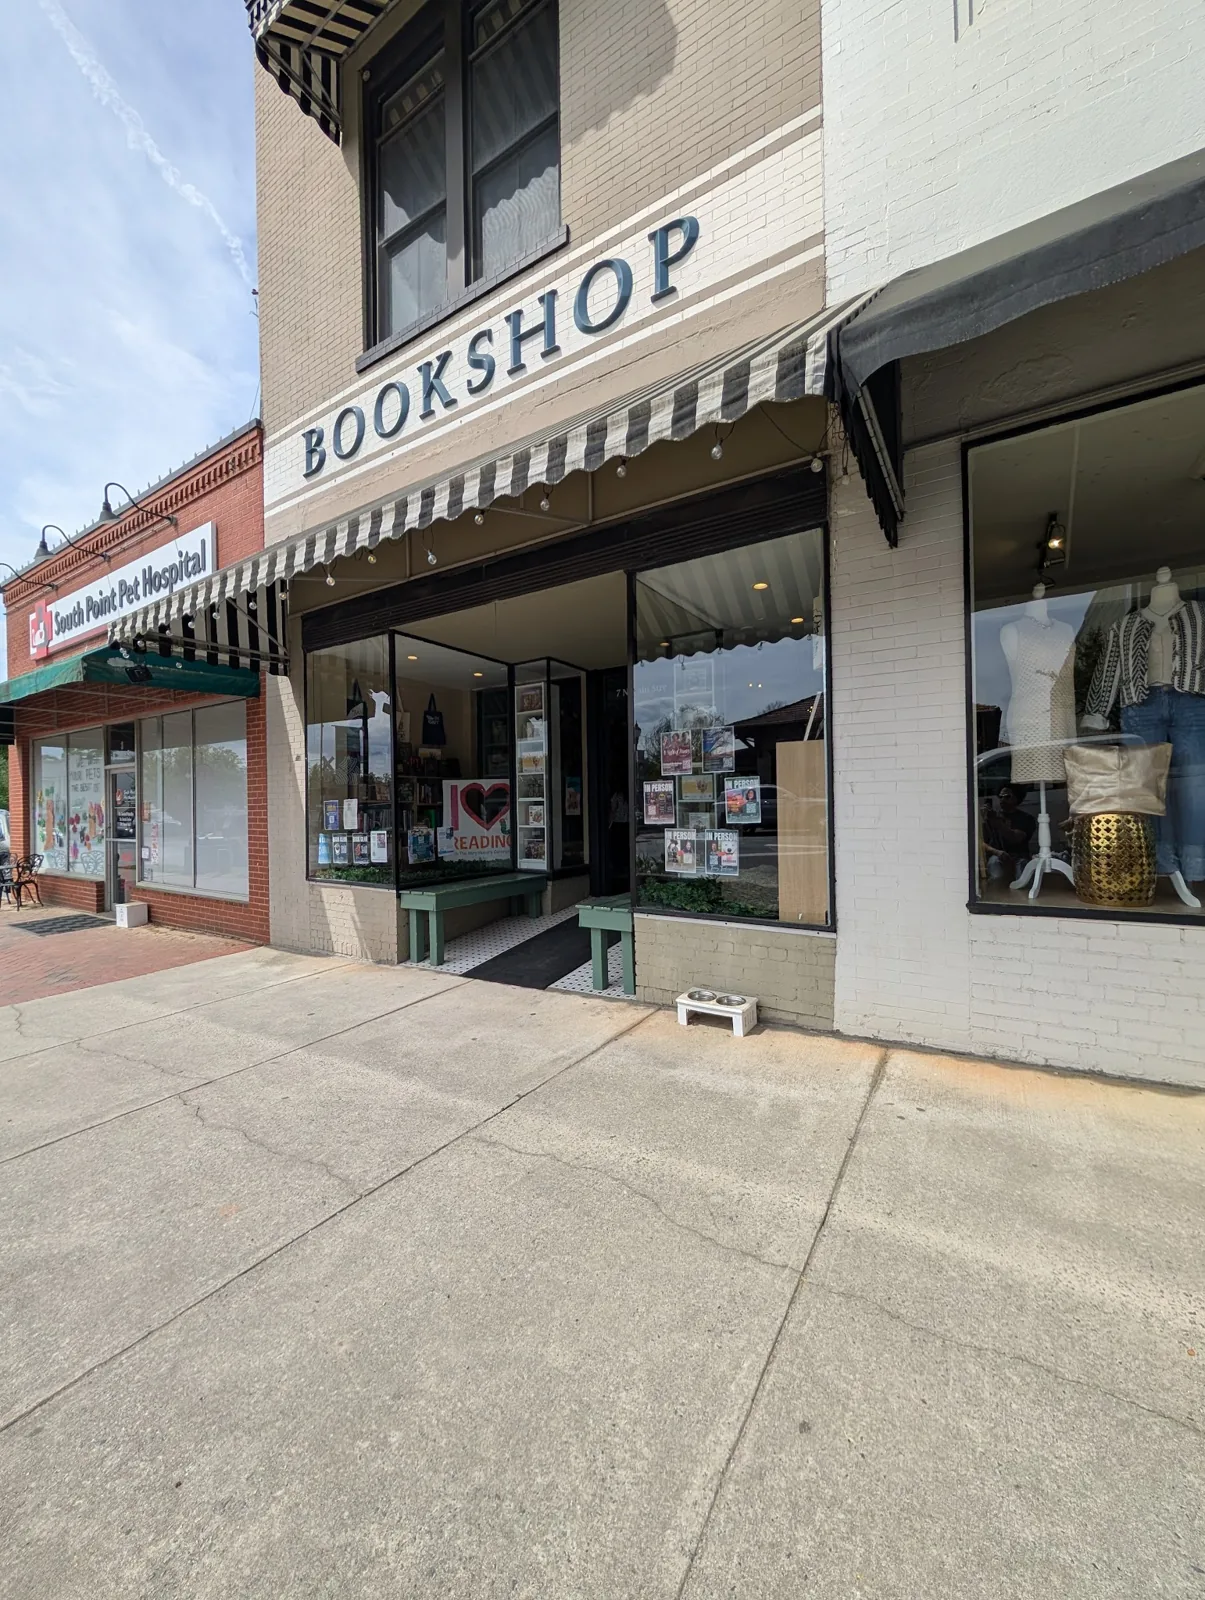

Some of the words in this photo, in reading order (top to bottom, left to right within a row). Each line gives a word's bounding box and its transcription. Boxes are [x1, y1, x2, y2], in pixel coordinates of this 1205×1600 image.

[301, 215, 700, 479] BOOKSHOP
[54, 600, 85, 636] South
[85, 590, 117, 623] Point
[118, 575, 141, 608] Pet
[141, 538, 207, 594] Hospital
[85, 767, 101, 780] PETS
[651, 783, 673, 792] PERSON
[450, 785, 459, 831] I
[673, 831, 696, 841] PERSON
[713, 832, 738, 842] PERSON
